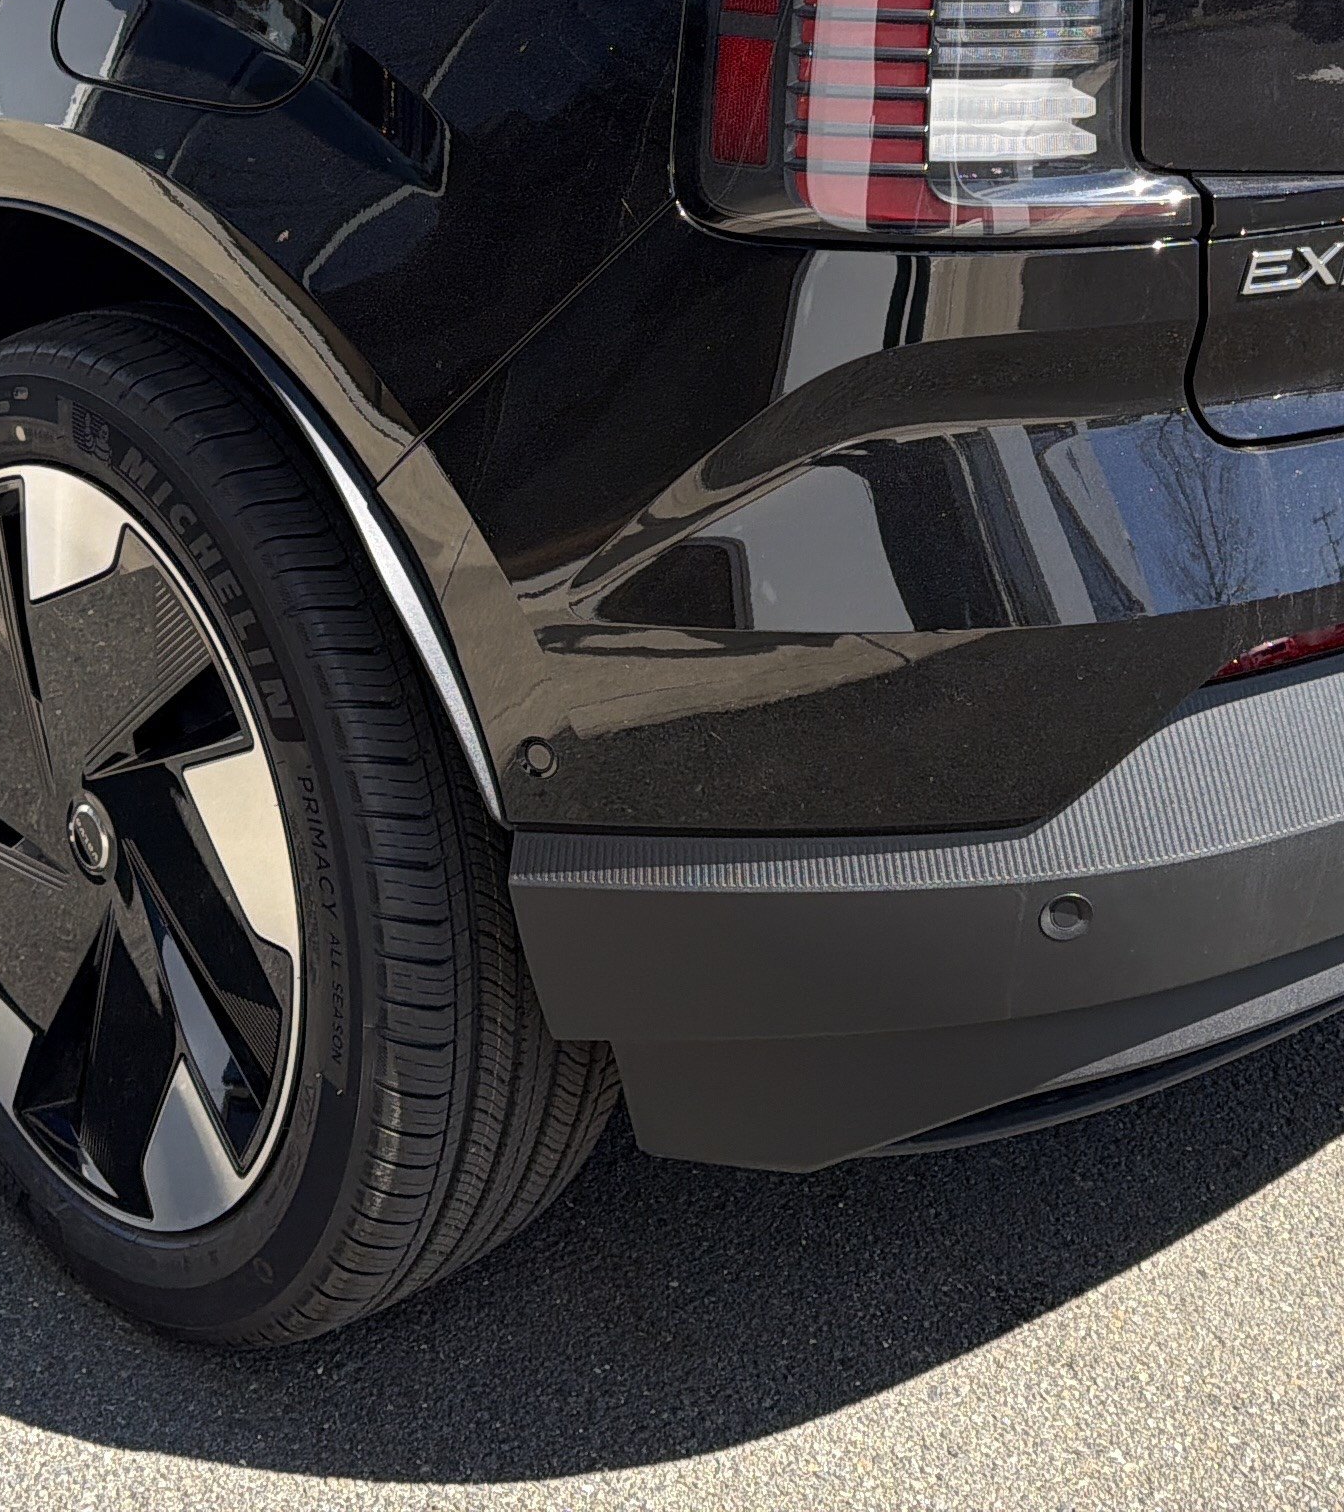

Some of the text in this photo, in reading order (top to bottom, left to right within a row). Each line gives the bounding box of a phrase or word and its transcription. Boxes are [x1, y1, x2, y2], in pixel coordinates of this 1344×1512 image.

[119, 445, 296, 721] MICHELIN
[297, 774, 344, 1066] PRIMACY ALL SEASON
